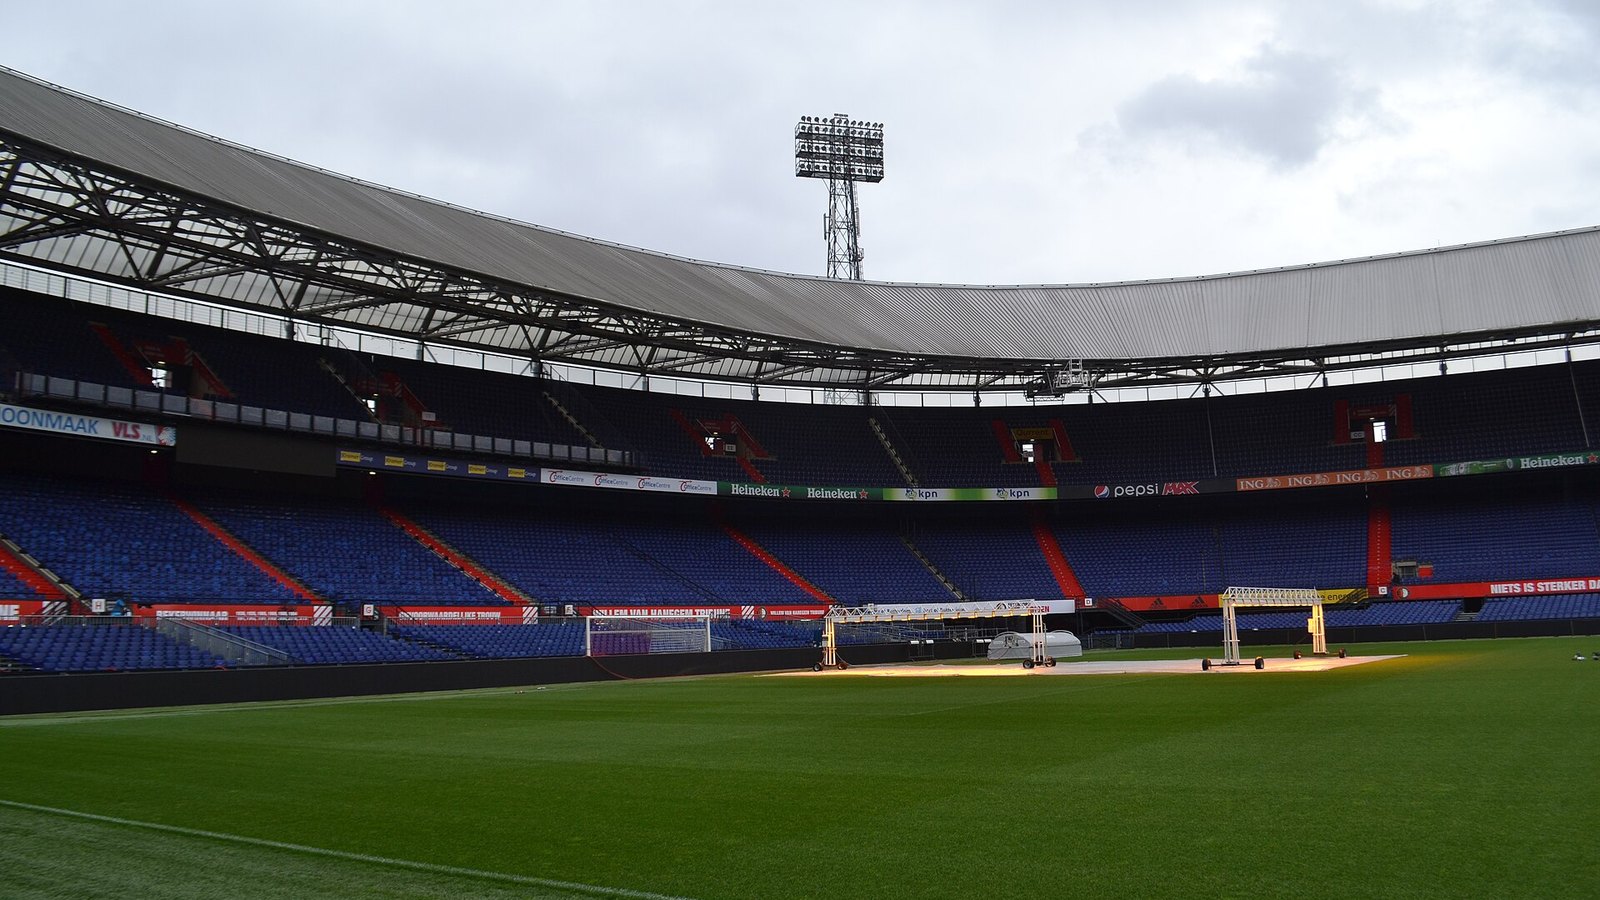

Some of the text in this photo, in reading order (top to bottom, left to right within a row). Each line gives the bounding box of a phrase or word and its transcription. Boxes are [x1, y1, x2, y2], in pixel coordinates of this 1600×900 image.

[1, 407, 99, 435] OONMAAK
[111, 420, 141, 440] VLS
[1520, 455, 1585, 469] Heineken
[1336, 472, 1361, 483] ING
[1385, 469, 1412, 480] ING
[1239, 479, 1264, 489] ING
[1287, 476, 1312, 486] ING
[731, 483, 780, 497] Heineken
[807, 487, 857, 499] Heineken
[918, 490, 938, 500] kpn
[1009, 489, 1030, 499] kpn
[1114, 481, 1200, 498] pepsi MAX
[1490, 583, 1521, 594] NIETS
[1523, 582, 1535, 593] IS
[1537, 580, 1586, 592] STERKER
